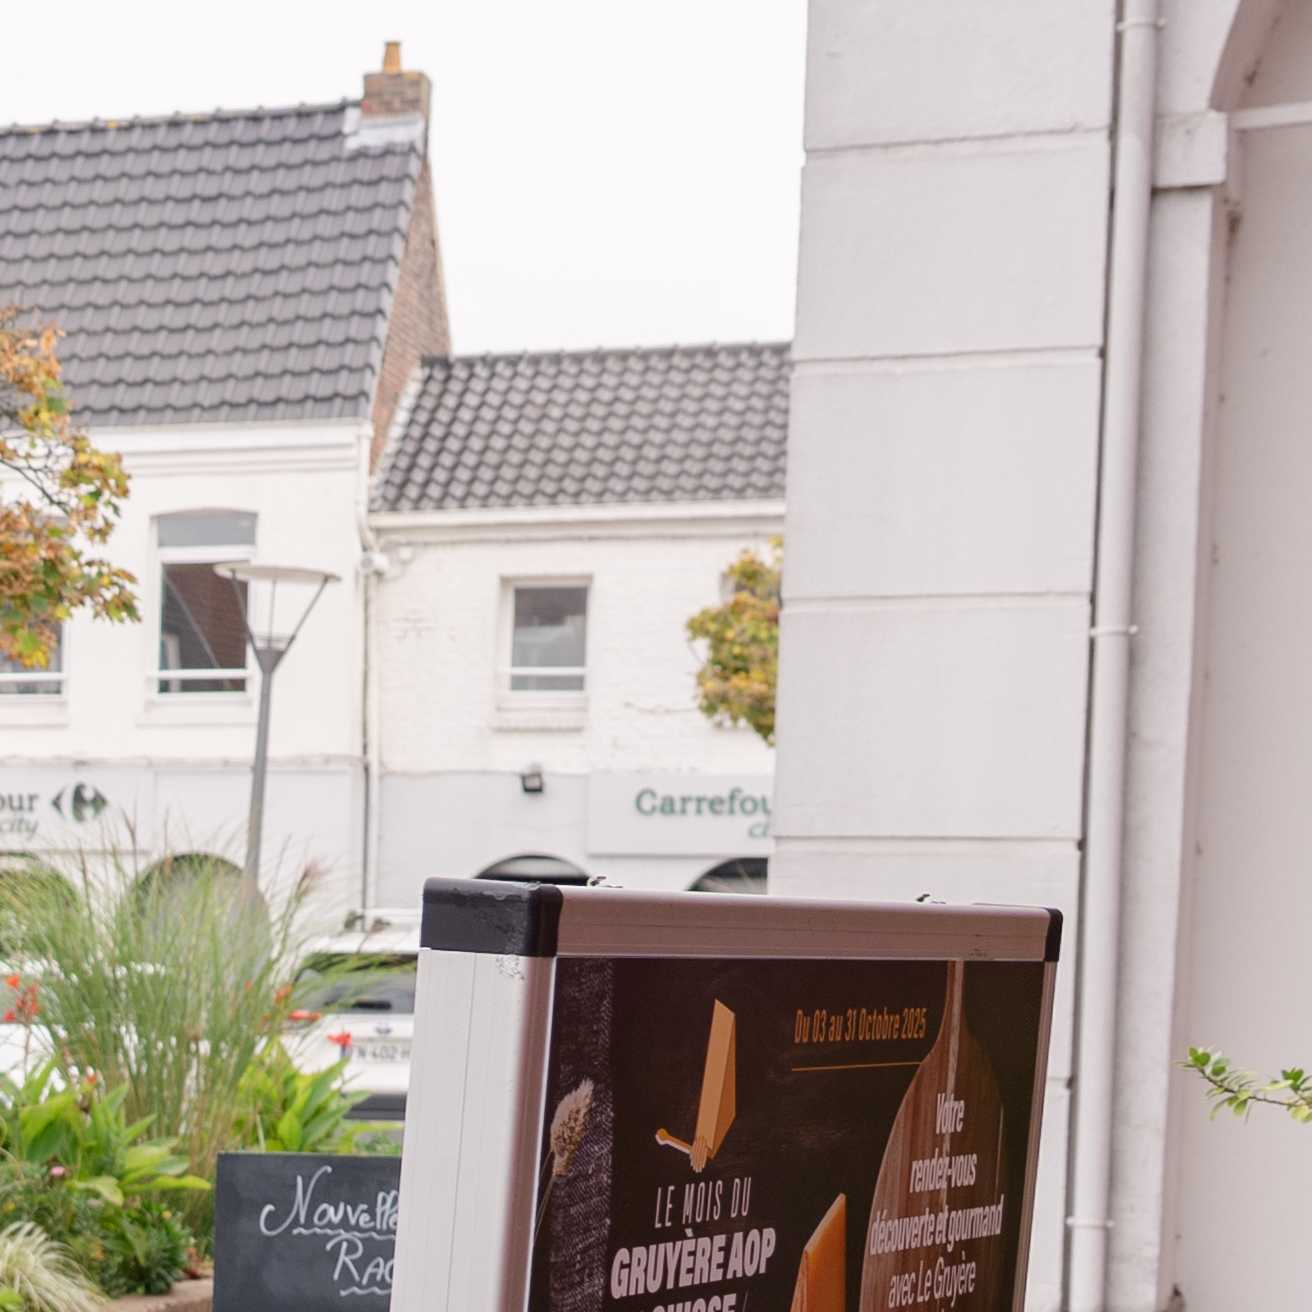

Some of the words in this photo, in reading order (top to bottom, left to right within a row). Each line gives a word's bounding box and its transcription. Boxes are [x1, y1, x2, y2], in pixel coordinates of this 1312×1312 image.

[635, 787, 771, 816] Carrefou
[794, 1009, 810, 1043] Du
[812, 1009, 826, 1042] 03
[828, 1015, 843, 1041] au
[845, 1009, 857, 1041] 31
[858, 1007, 900, 1040] Octobre
[901, 1008, 927, 1039] 2025
[936, 1093, 965, 1134] Votre
[909, 1148, 977, 1193] rendez-vous
[655, 1185, 675, 1228] LE
[682, 1180, 723, 1225] MOIS
[731, 1177, 752, 1218] DU
[870, 1206, 936, 1256] découverte
[936, 1204, 949, 1245] et
[948, 1194, 1004, 1253] gourmand
[610, 1228, 726, 1299] GRUYÈRE
[727, 1227, 776, 1279] AOP
[888, 1268, 916, 1308] avec
[917, 1260, 932, 1303] Le
[933, 1251, 976, 1308] Gruyère
